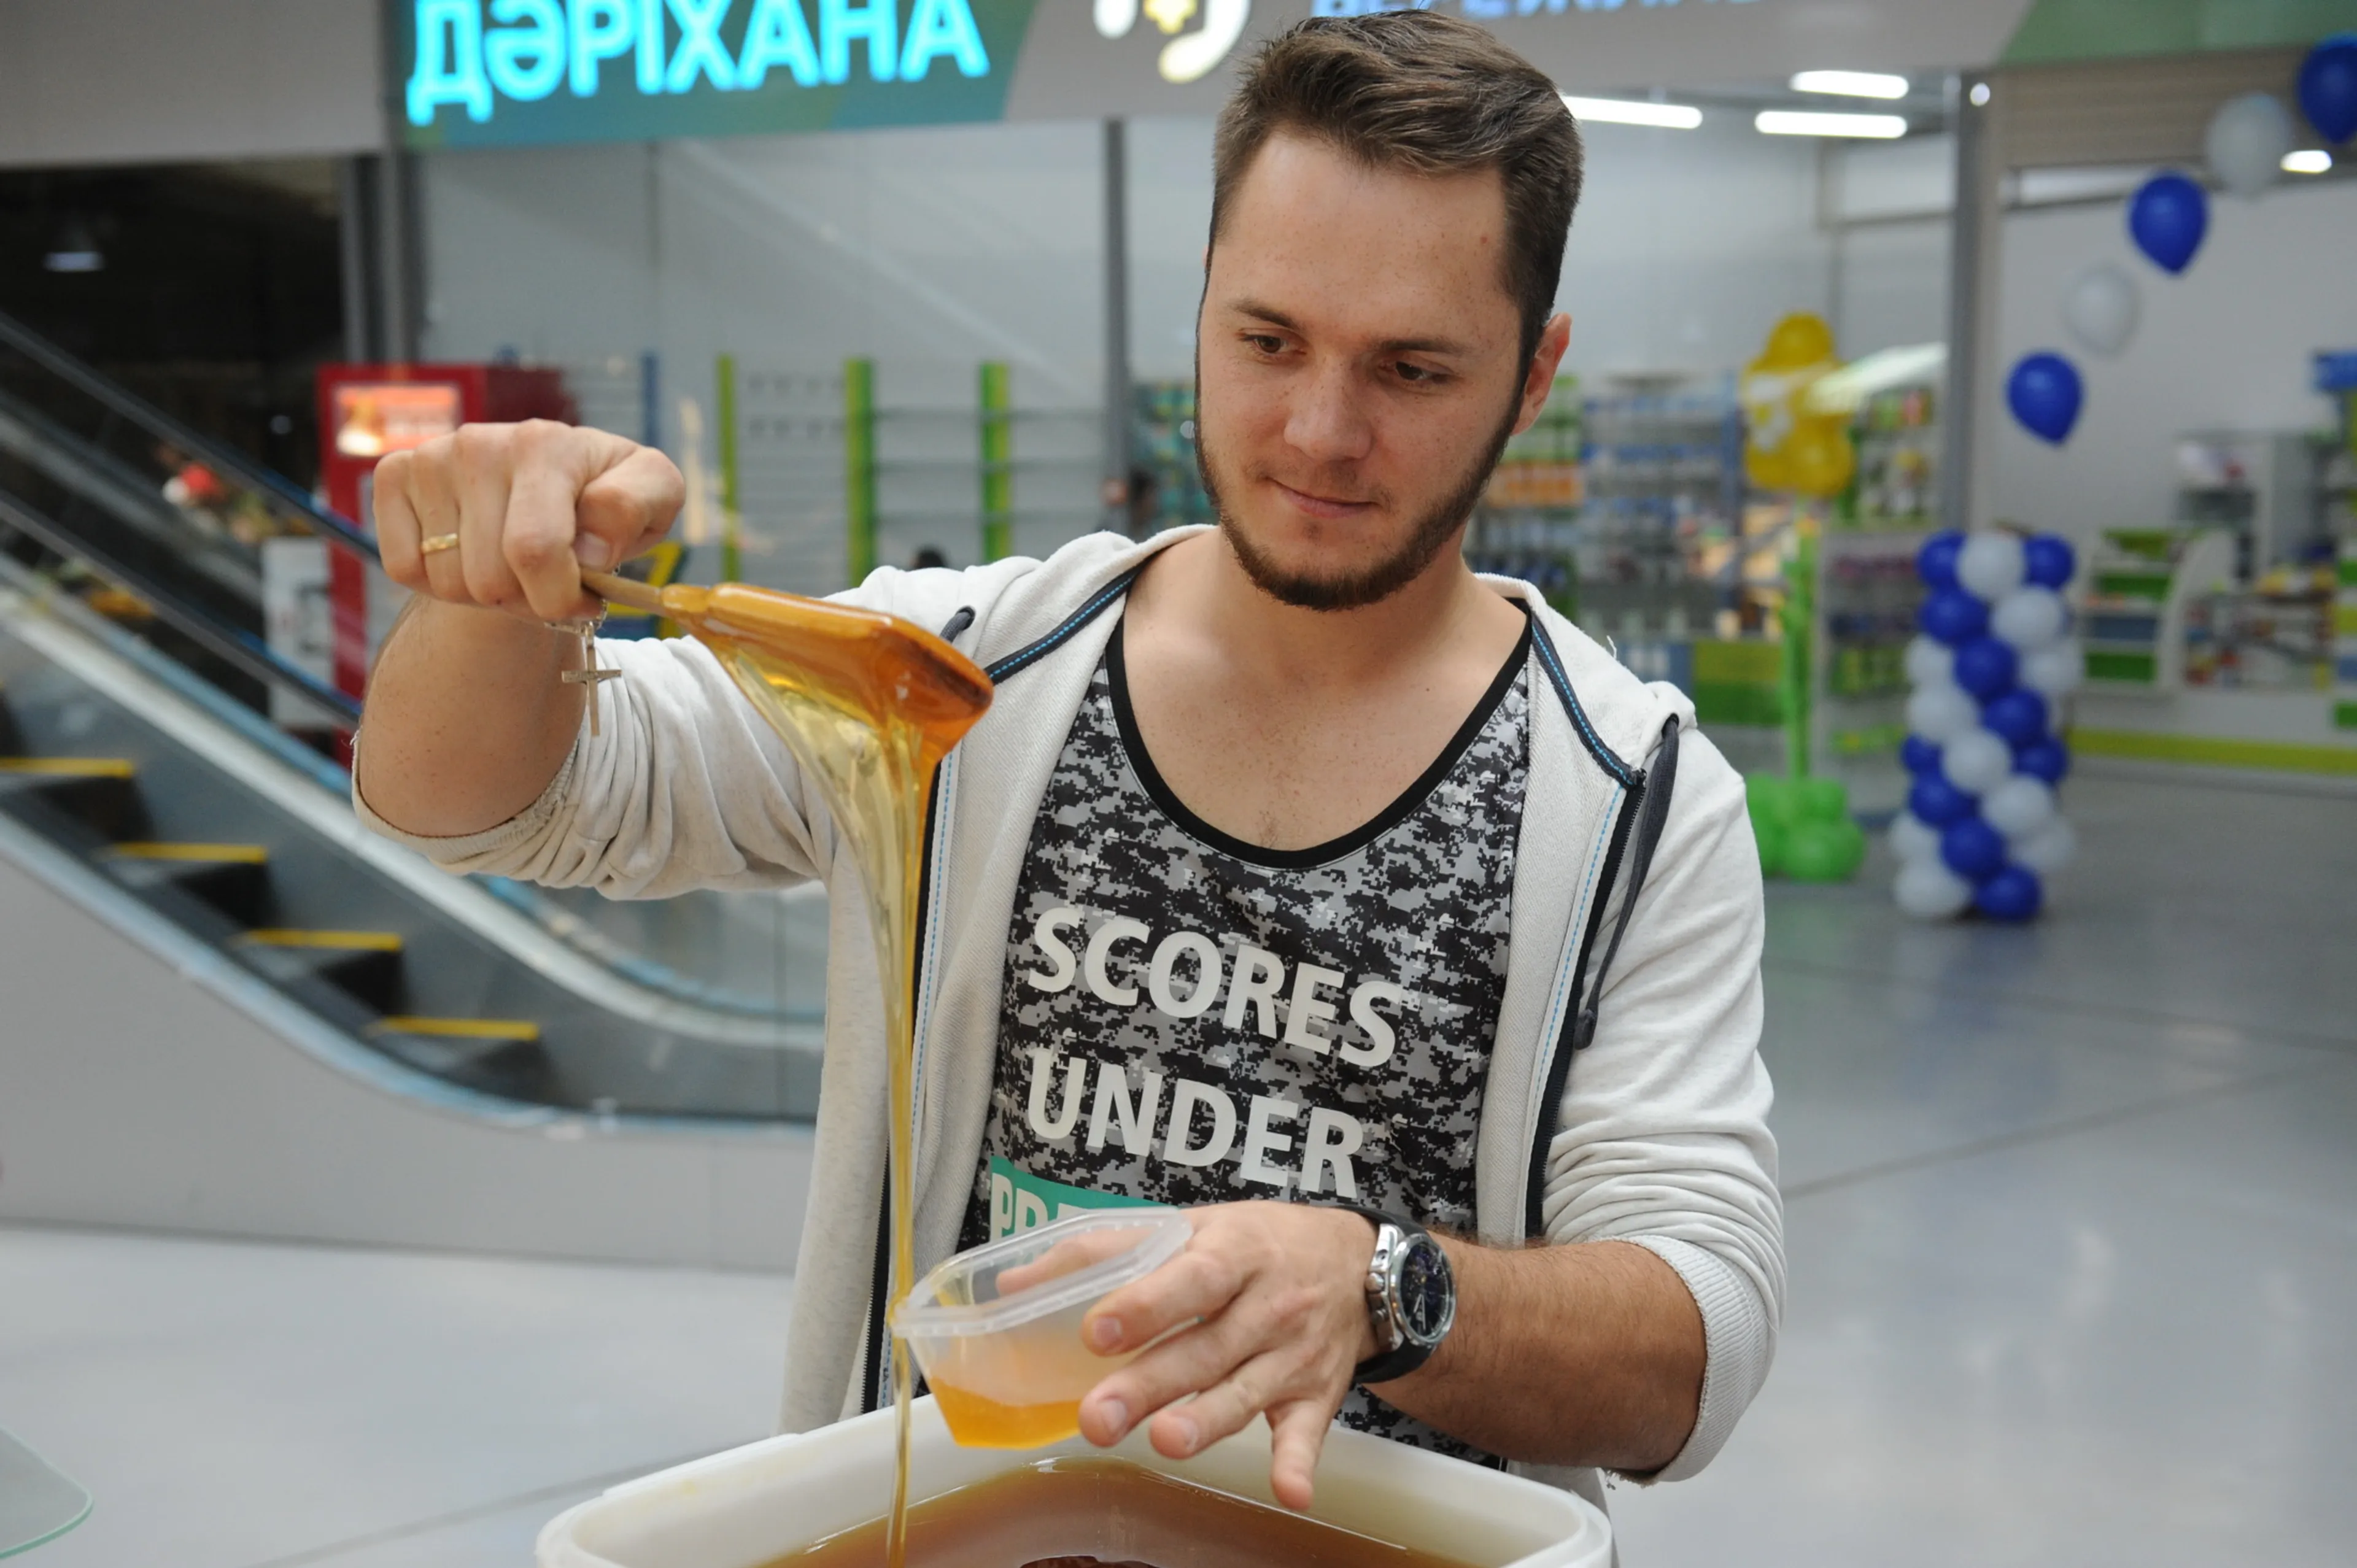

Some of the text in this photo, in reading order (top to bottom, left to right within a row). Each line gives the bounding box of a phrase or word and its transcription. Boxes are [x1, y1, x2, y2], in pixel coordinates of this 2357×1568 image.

[406, 0, 990, 126] ДӘРІХАНА
[1028, 906, 1404, 1068] SCORES
[1027, 1046, 1363, 1199] UNDER
